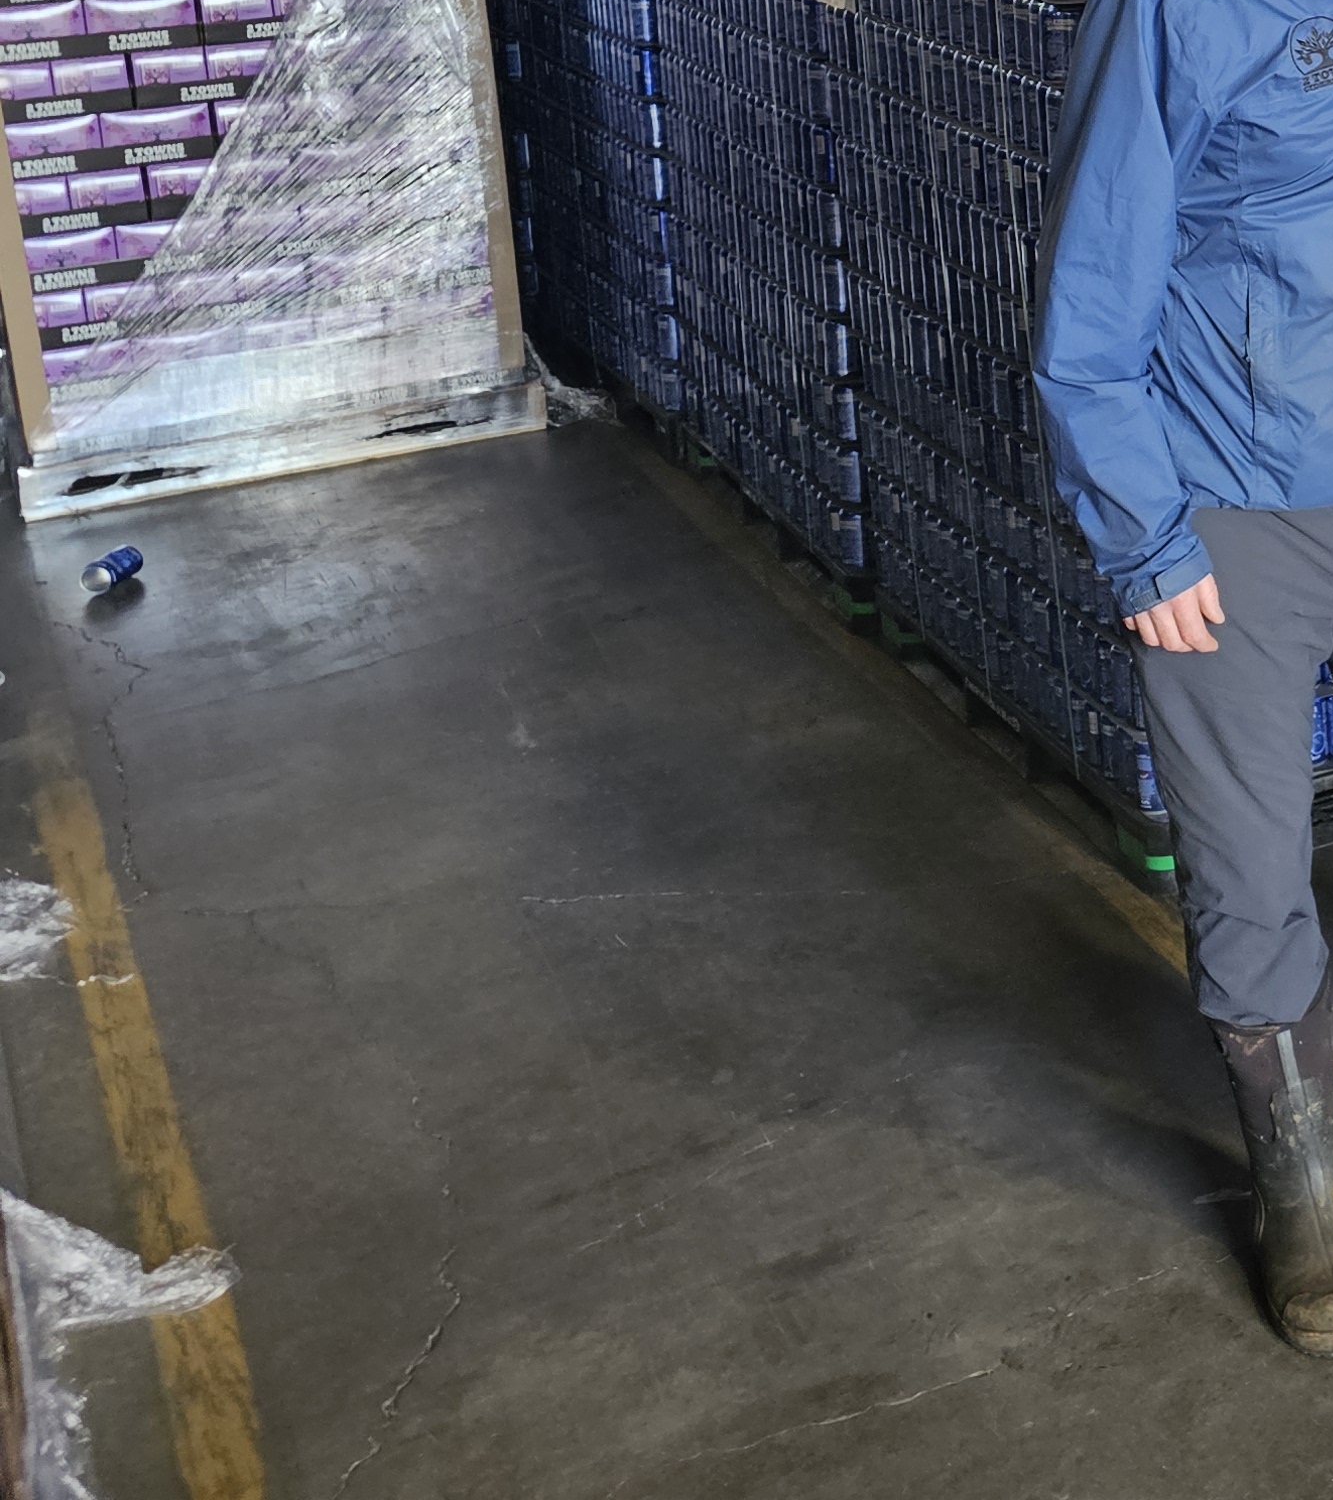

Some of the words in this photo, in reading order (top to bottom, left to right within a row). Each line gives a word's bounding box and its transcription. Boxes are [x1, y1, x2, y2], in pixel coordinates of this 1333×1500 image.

[118, 30, 169, 43] TOWNS
[134, 143, 185, 157] TOWNS
[22, 155, 76, 169] TOWNS
